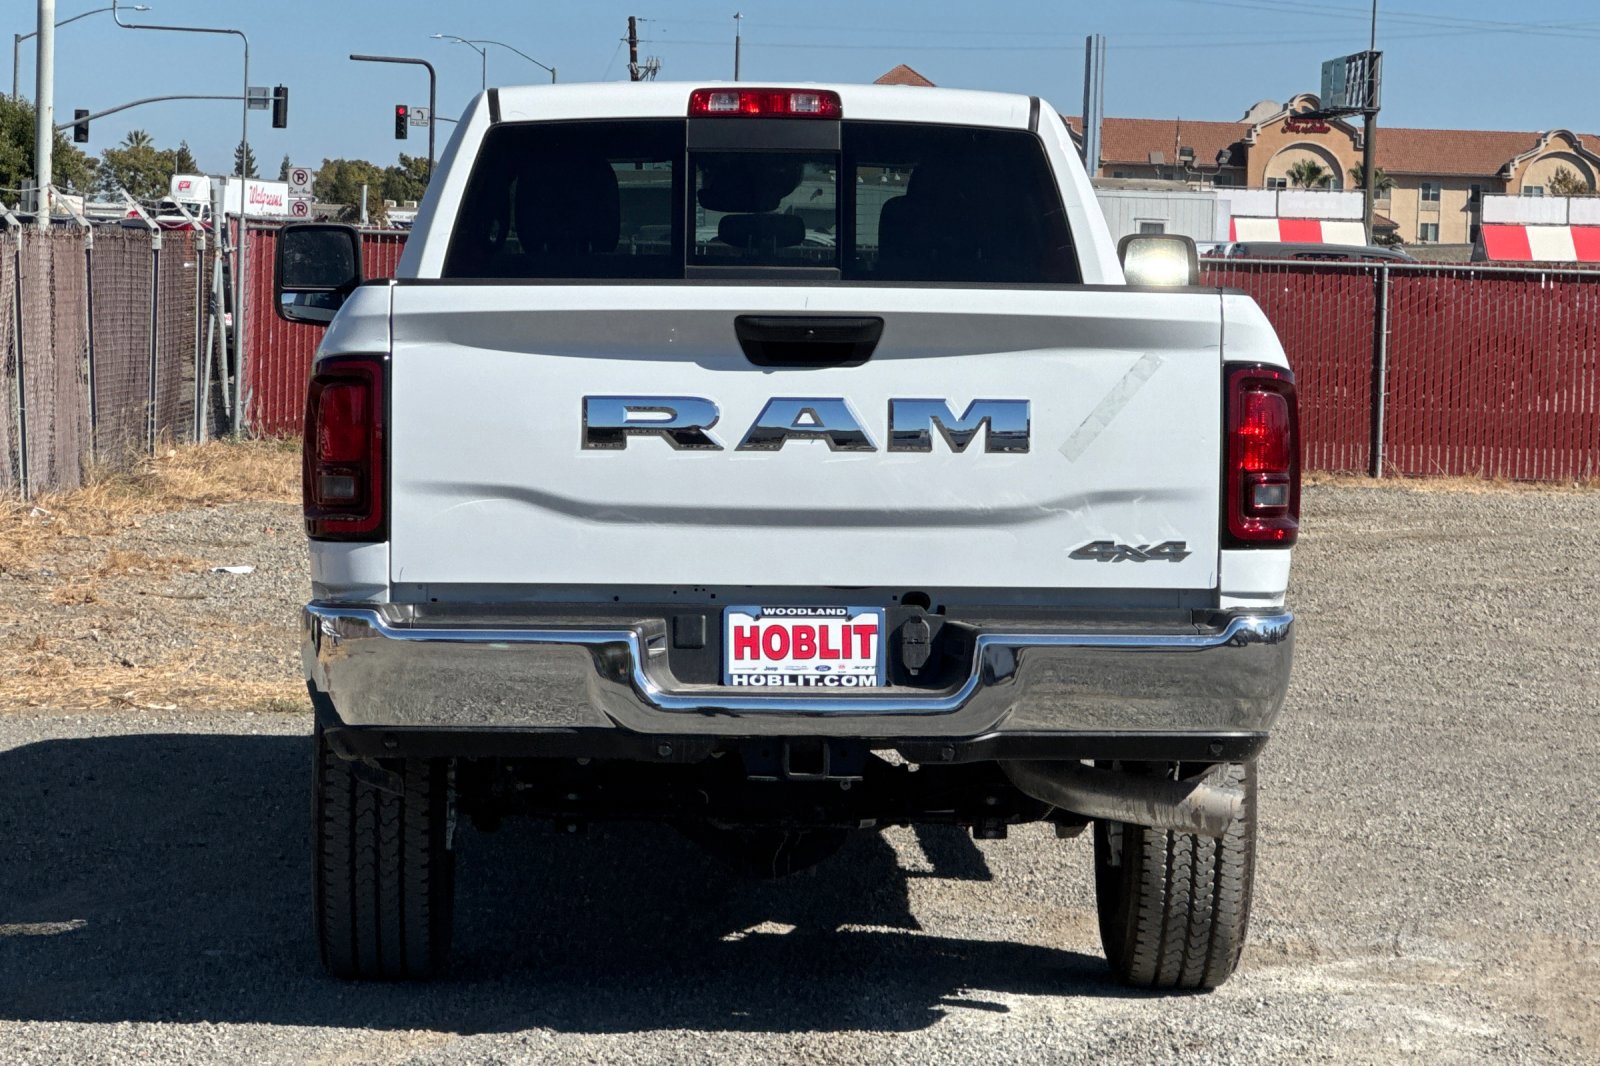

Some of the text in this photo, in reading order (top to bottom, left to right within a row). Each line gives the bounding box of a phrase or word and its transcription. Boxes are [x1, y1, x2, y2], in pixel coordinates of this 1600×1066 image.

[249, 185, 283, 211] Walgreens
[581, 394, 1031, 453] RAM
[762, 607, 847, 616] WOODLAND
[734, 624, 878, 661] HOBLIT
[732, 675, 877, 687] HOBLIT.COM
